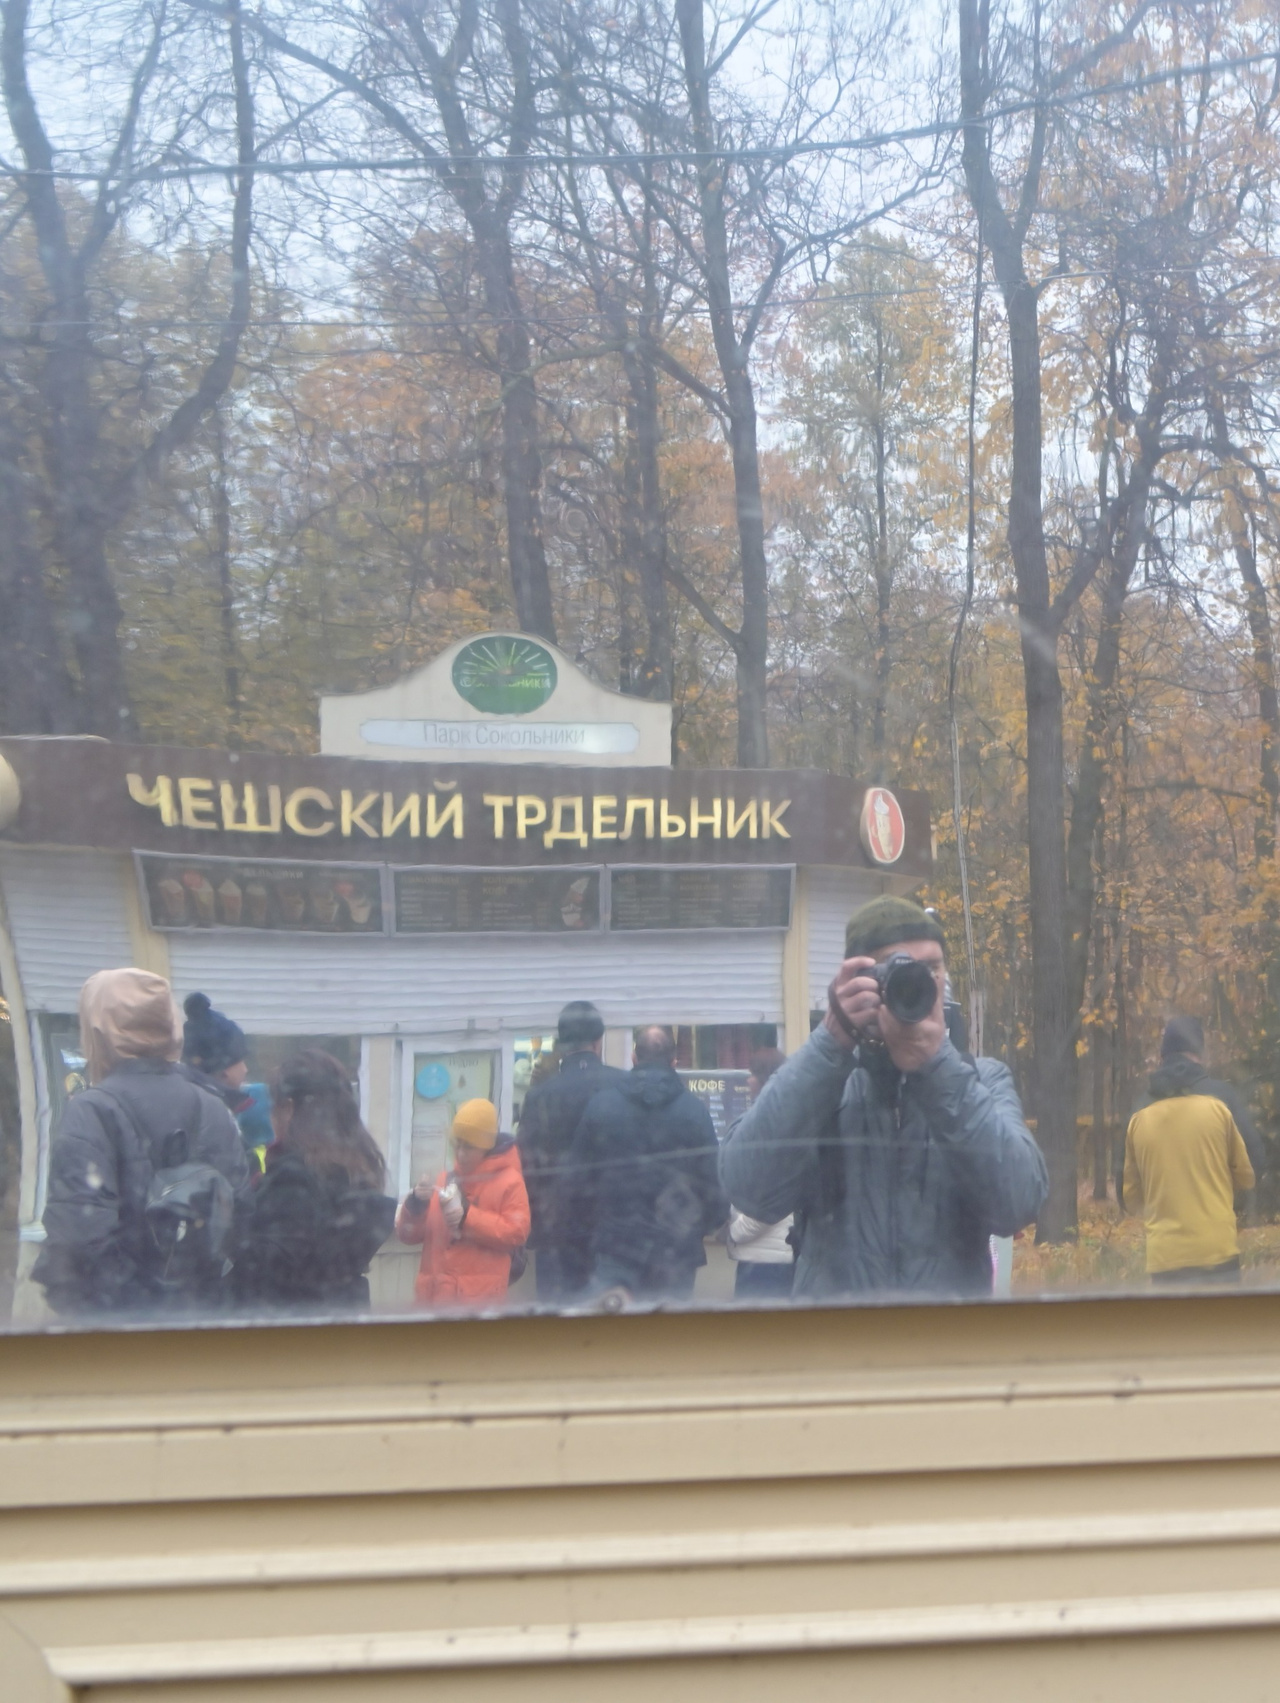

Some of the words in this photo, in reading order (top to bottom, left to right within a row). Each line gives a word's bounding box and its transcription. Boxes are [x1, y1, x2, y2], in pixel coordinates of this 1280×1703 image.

[423, 722, 471, 748] Парк
[475, 722, 585, 745] Сокольники
[126, 772, 464, 839] ЧЕШСКИЙ
[482, 793, 792, 849] ТРДЕЛЬНИК
[688, 1079, 726, 1093] КОФЕ
